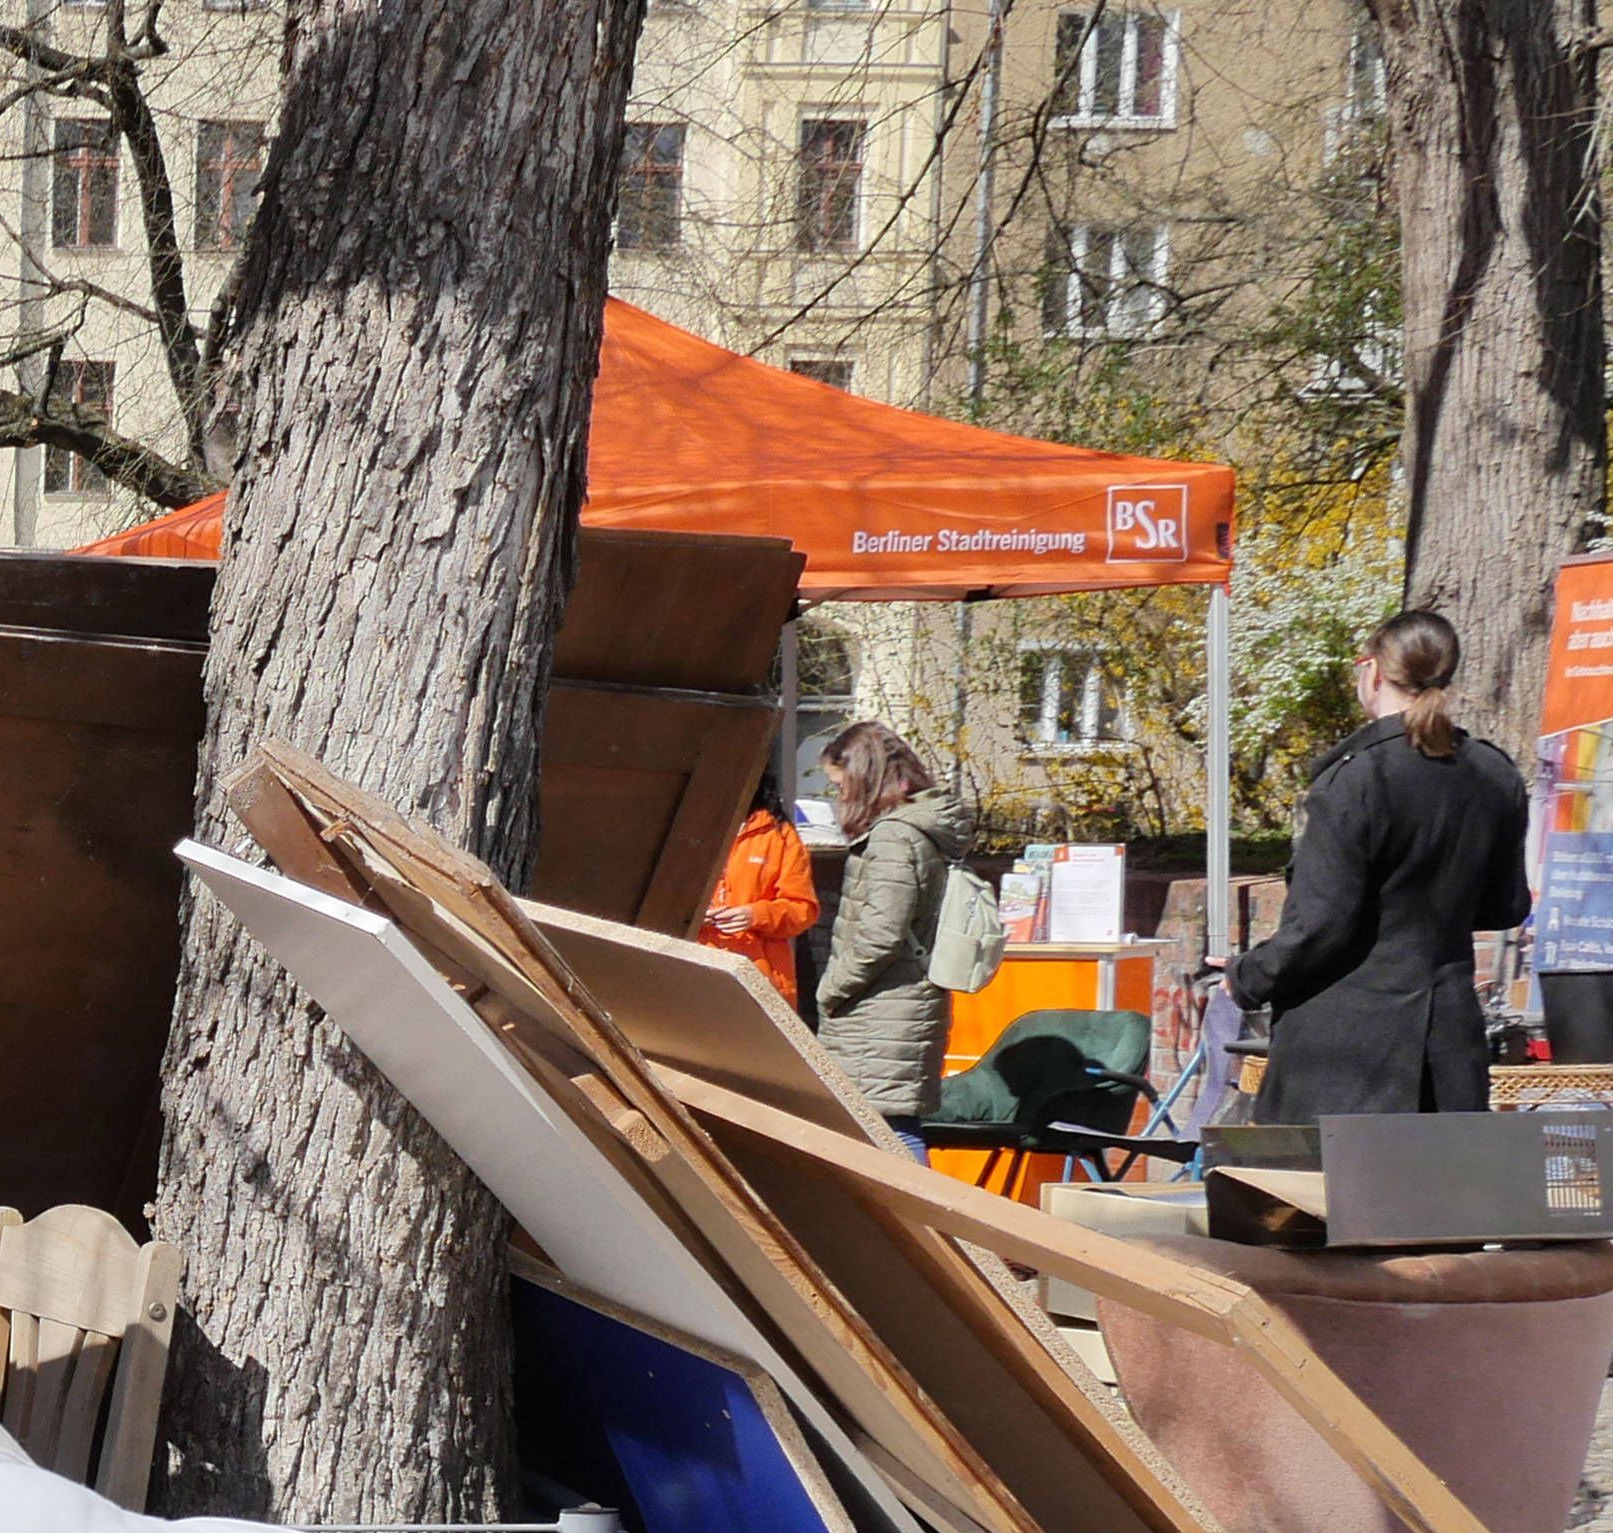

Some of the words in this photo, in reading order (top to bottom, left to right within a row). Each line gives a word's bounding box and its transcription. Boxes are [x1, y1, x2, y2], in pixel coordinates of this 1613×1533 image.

[852, 530, 933, 554] Berliner
[937, 528, 1086, 555] Stadtreinigung
[1114, 500, 1179, 550] BSR
